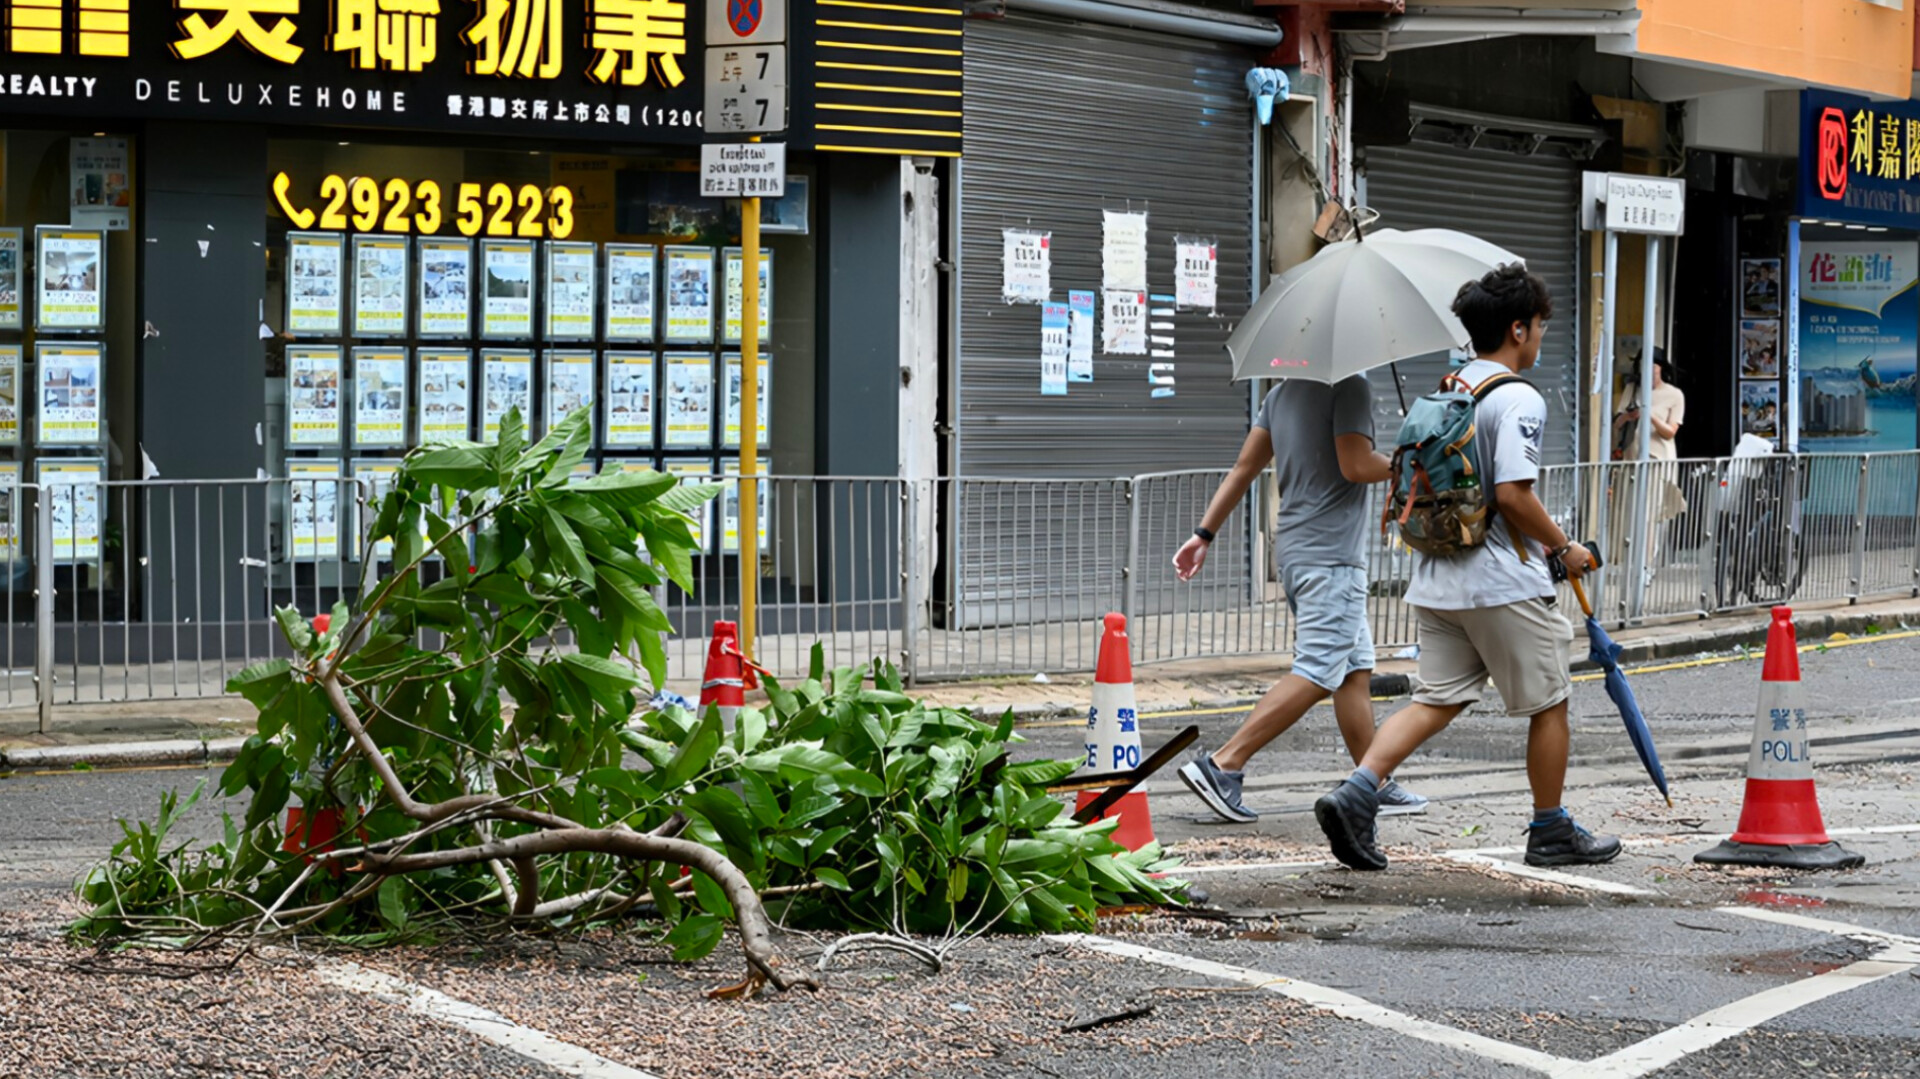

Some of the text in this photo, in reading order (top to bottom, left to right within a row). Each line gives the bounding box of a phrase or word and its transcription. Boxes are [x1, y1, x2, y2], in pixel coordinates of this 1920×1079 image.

[756, 52, 770, 80] 7
[755, 98, 769, 126] 7
[319, 174, 574, 239] 2923 5223
